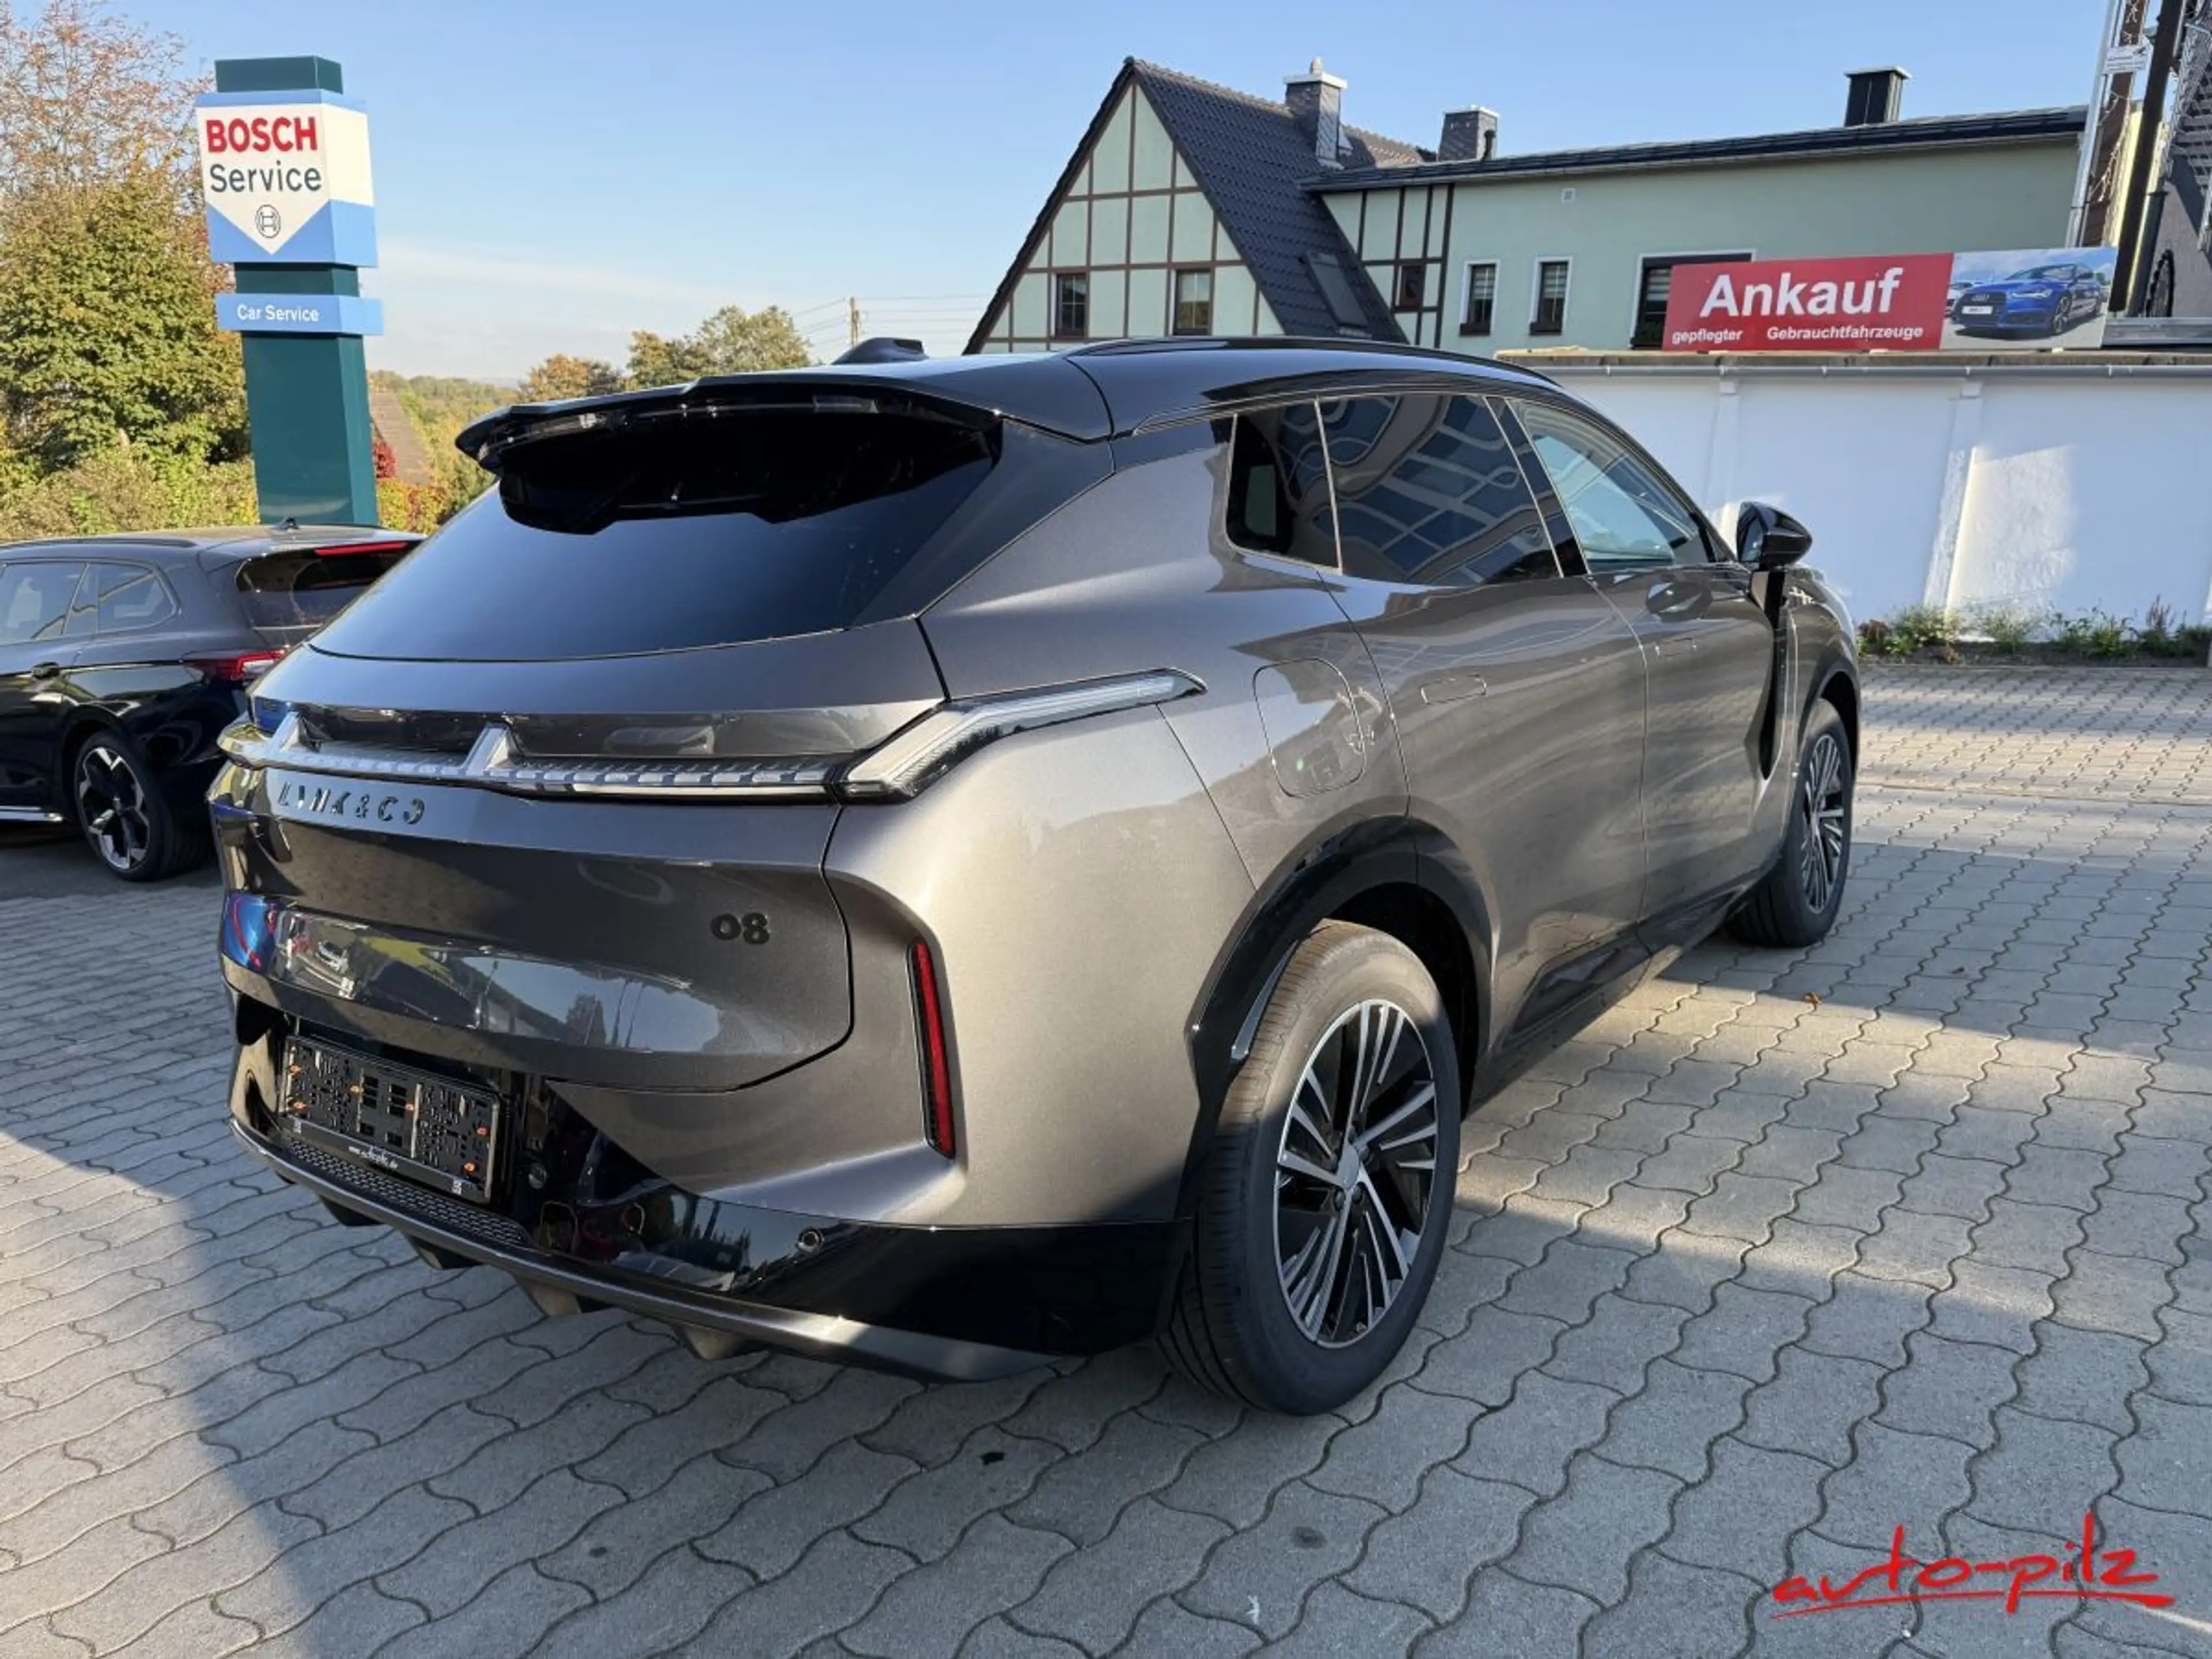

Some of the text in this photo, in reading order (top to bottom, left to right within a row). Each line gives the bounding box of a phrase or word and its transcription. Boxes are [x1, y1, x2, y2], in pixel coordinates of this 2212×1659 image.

[206, 116, 318, 153] BOSCH
[210, 160, 321, 193] Service
[1699, 267, 1904, 318] Ankauf
[237, 304, 319, 323] Car Service
[1672, 325, 1924, 344] gepflegter Gebrauchtfahrzeuge
[710, 912, 770, 945] 08
